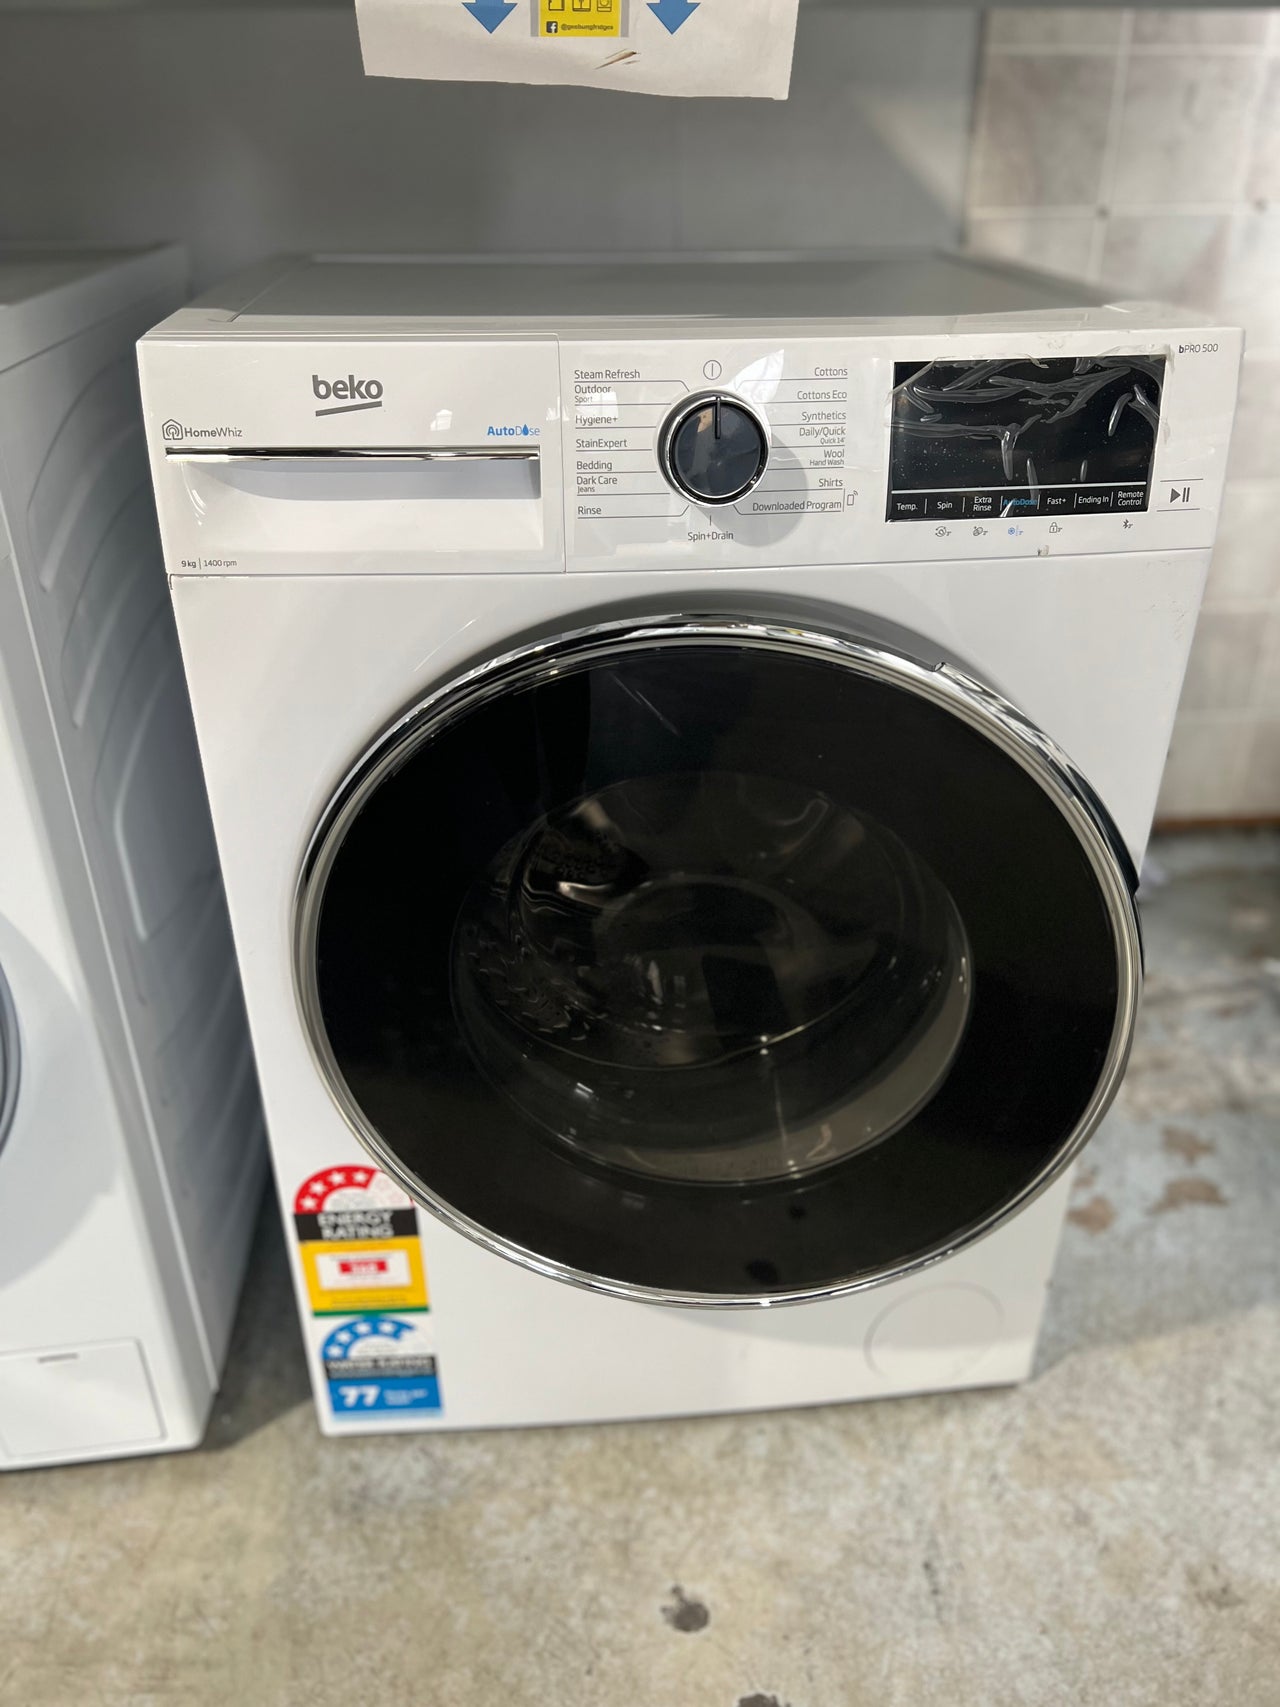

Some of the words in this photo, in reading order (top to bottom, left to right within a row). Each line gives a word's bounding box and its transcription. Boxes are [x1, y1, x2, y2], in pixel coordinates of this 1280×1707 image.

[1178, 344, 1201, 354] bPRO
[1202, 343, 1219, 353] 500
[574, 369, 604, 379] Steam
[605, 369, 641, 379] Refresh
[814, 366, 848, 377] Cottons
[312, 374, 384, 400] beko
[574, 384, 612, 394] Outdoor
[574, 395, 593, 404] Sport
[797, 390, 831, 400] Cottons
[832, 389, 848, 399] Eco
[575, 414, 619, 426] Hygiene+
[801, 411, 847, 423] Synthetics
[184, 427, 243, 438] HomeWhiz
[487, 423, 541, 436] AutoDose
[799, 426, 847, 439] Daily/Quick
[575, 438, 628, 449] StainExpert
[820, 437, 836, 445] Quick
[823, 449, 845, 459] Wool
[576, 460, 613, 472] Bedding
[576, 475, 597, 486] Dark
[597, 475, 618, 485] Care
[818, 478, 844, 488] Shirts
[577, 485, 596, 494] Jeans
[1117, 490, 1144, 499] Remote
[974, 495, 992, 504] Extra
[1046, 497, 1066, 505] Fast+
[1078, 495, 1102, 505] Ending
[1102, 495, 1109, 503] In
[1117, 498, 1143, 506] Control
[577, 506, 602, 515] Rinse
[752, 501, 805, 512] Downloaded
[806, 500, 842, 512] Program
[896, 502, 918, 512] Temp.
[937, 501, 953, 510] Spin
[973, 503, 992, 512] Rinse
[687, 530, 734, 543] Spin+Drain
[181, 560, 187, 568] 9
[187, 560, 197, 568] kg
[204, 559, 223, 567] 1400
[223, 560, 238, 568] rpm
[338, 1385, 380, 1408] 77
